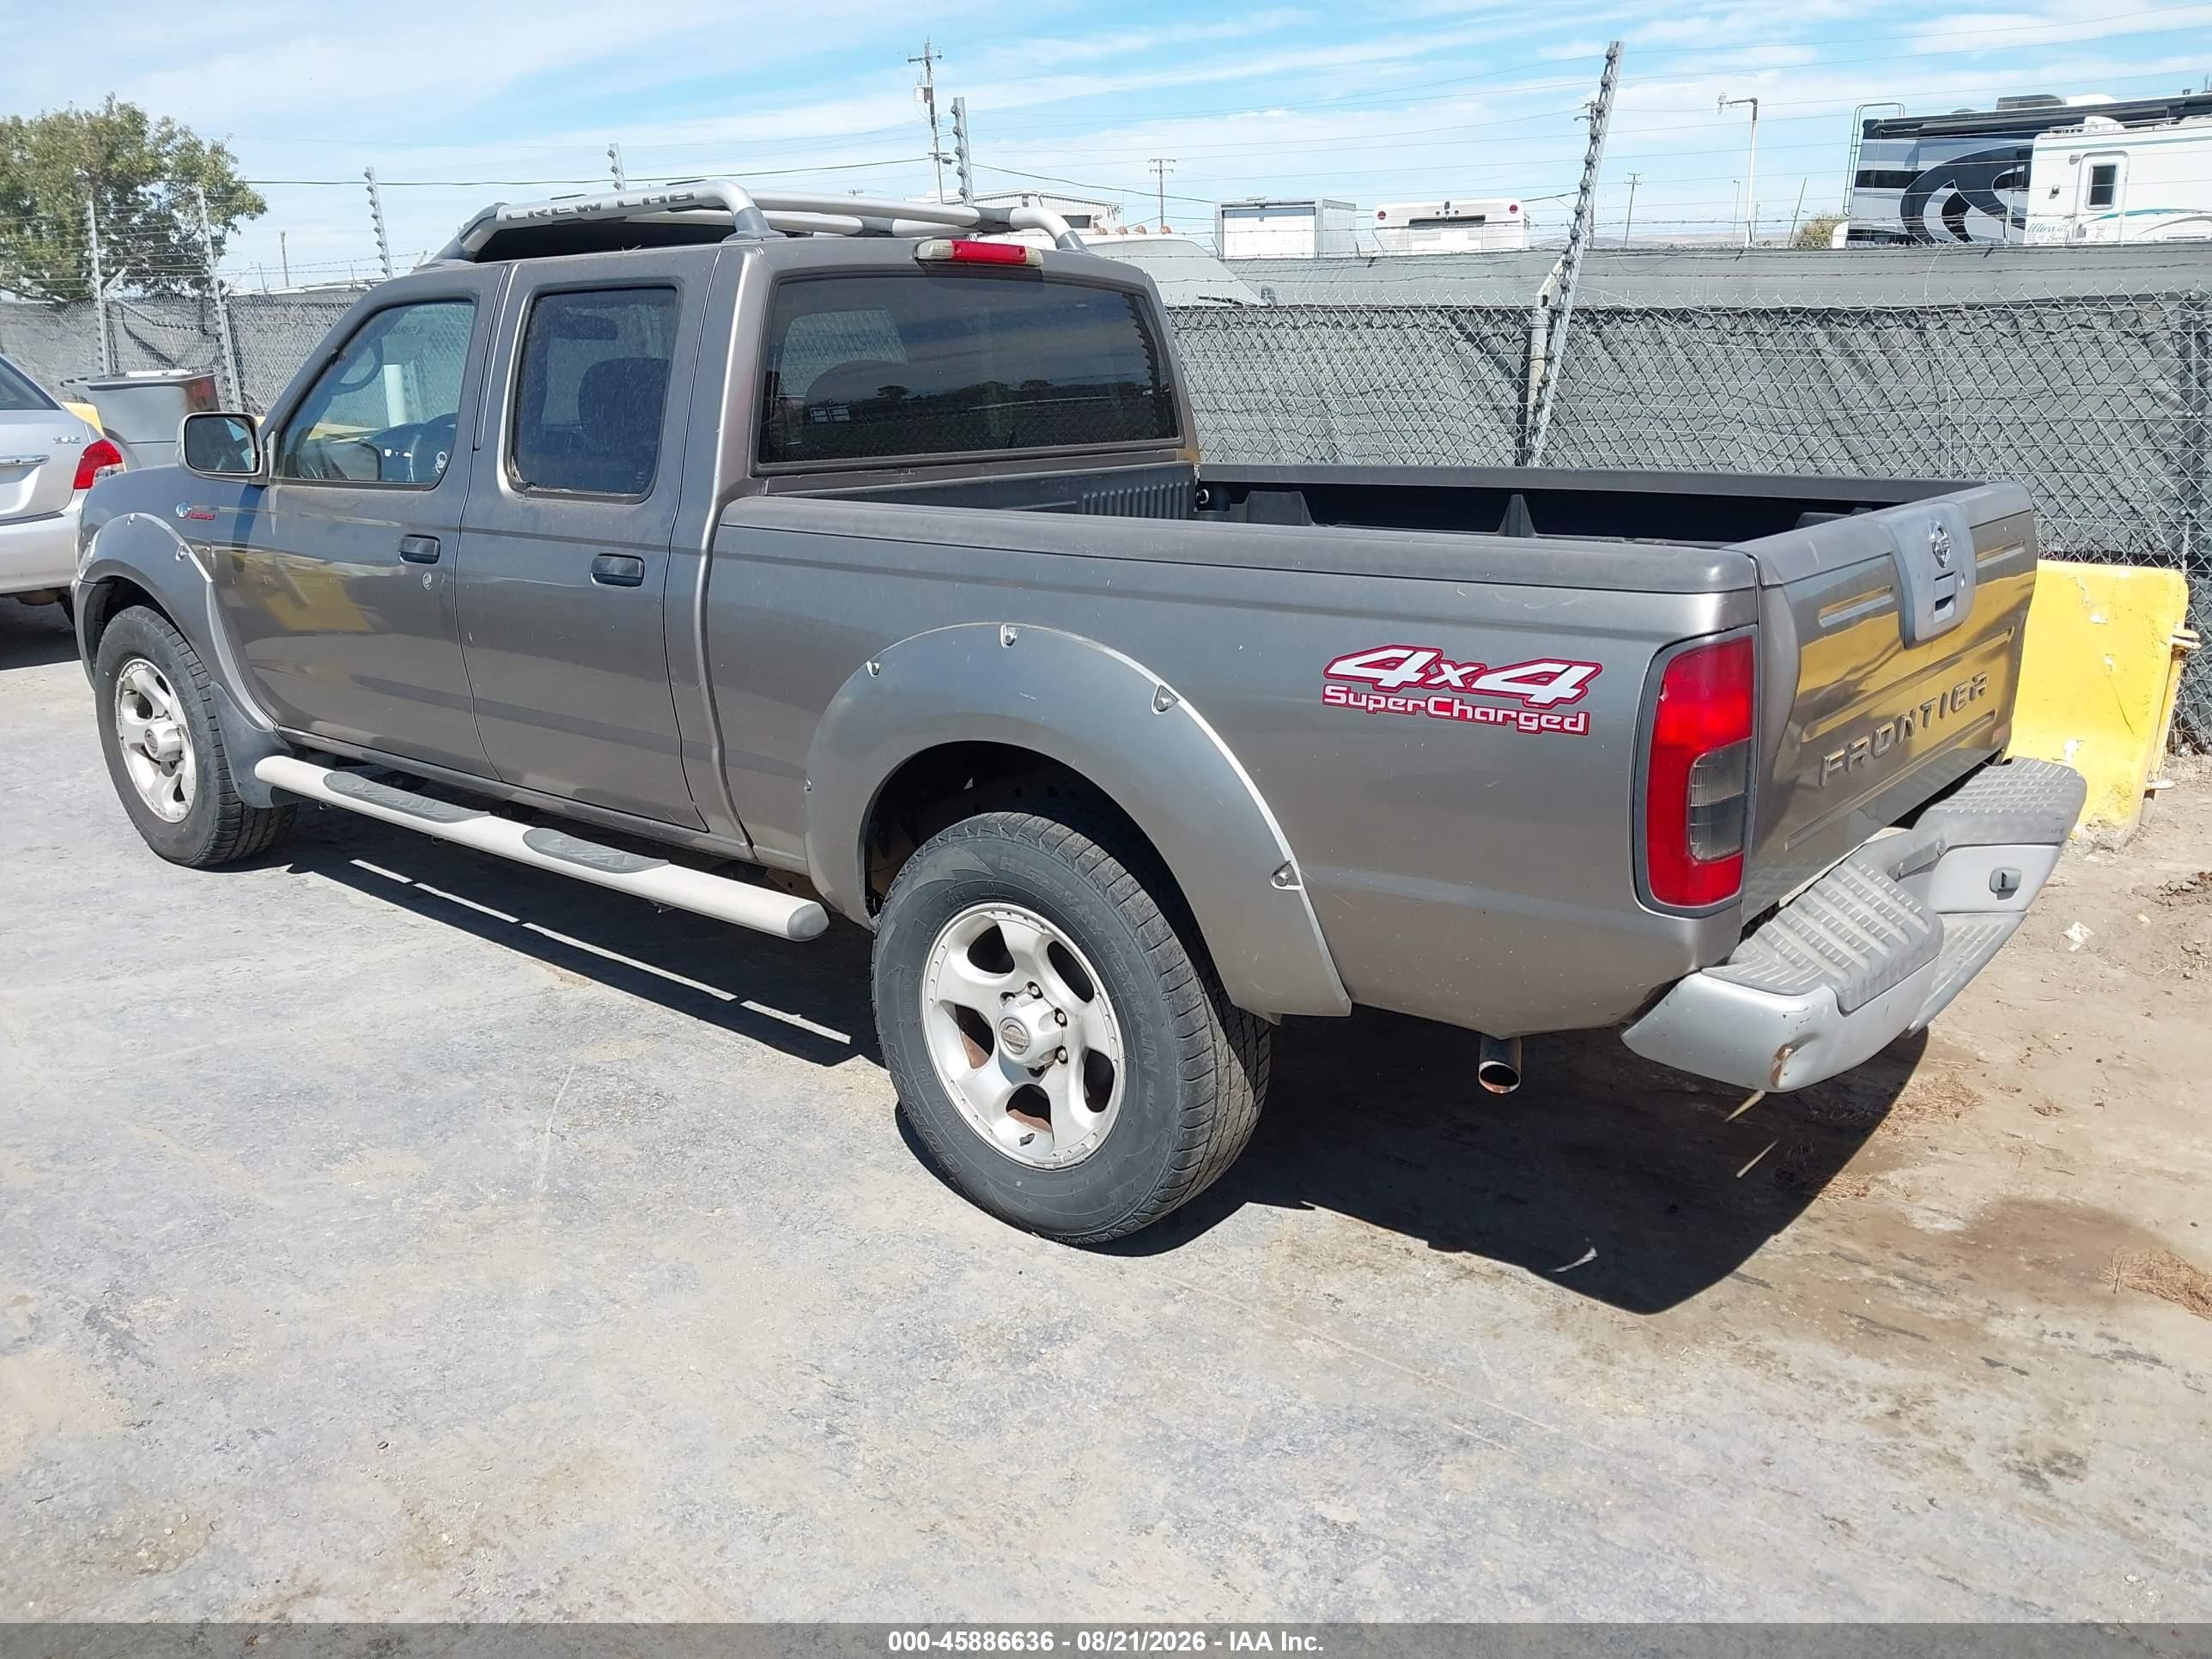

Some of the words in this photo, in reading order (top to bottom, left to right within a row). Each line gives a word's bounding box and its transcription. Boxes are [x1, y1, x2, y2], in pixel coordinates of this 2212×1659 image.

[1324, 645, 1602, 709] 4x4
[1322, 684, 1590, 736] SuperCharged
[1819, 670, 1989, 788] FRONTIER
